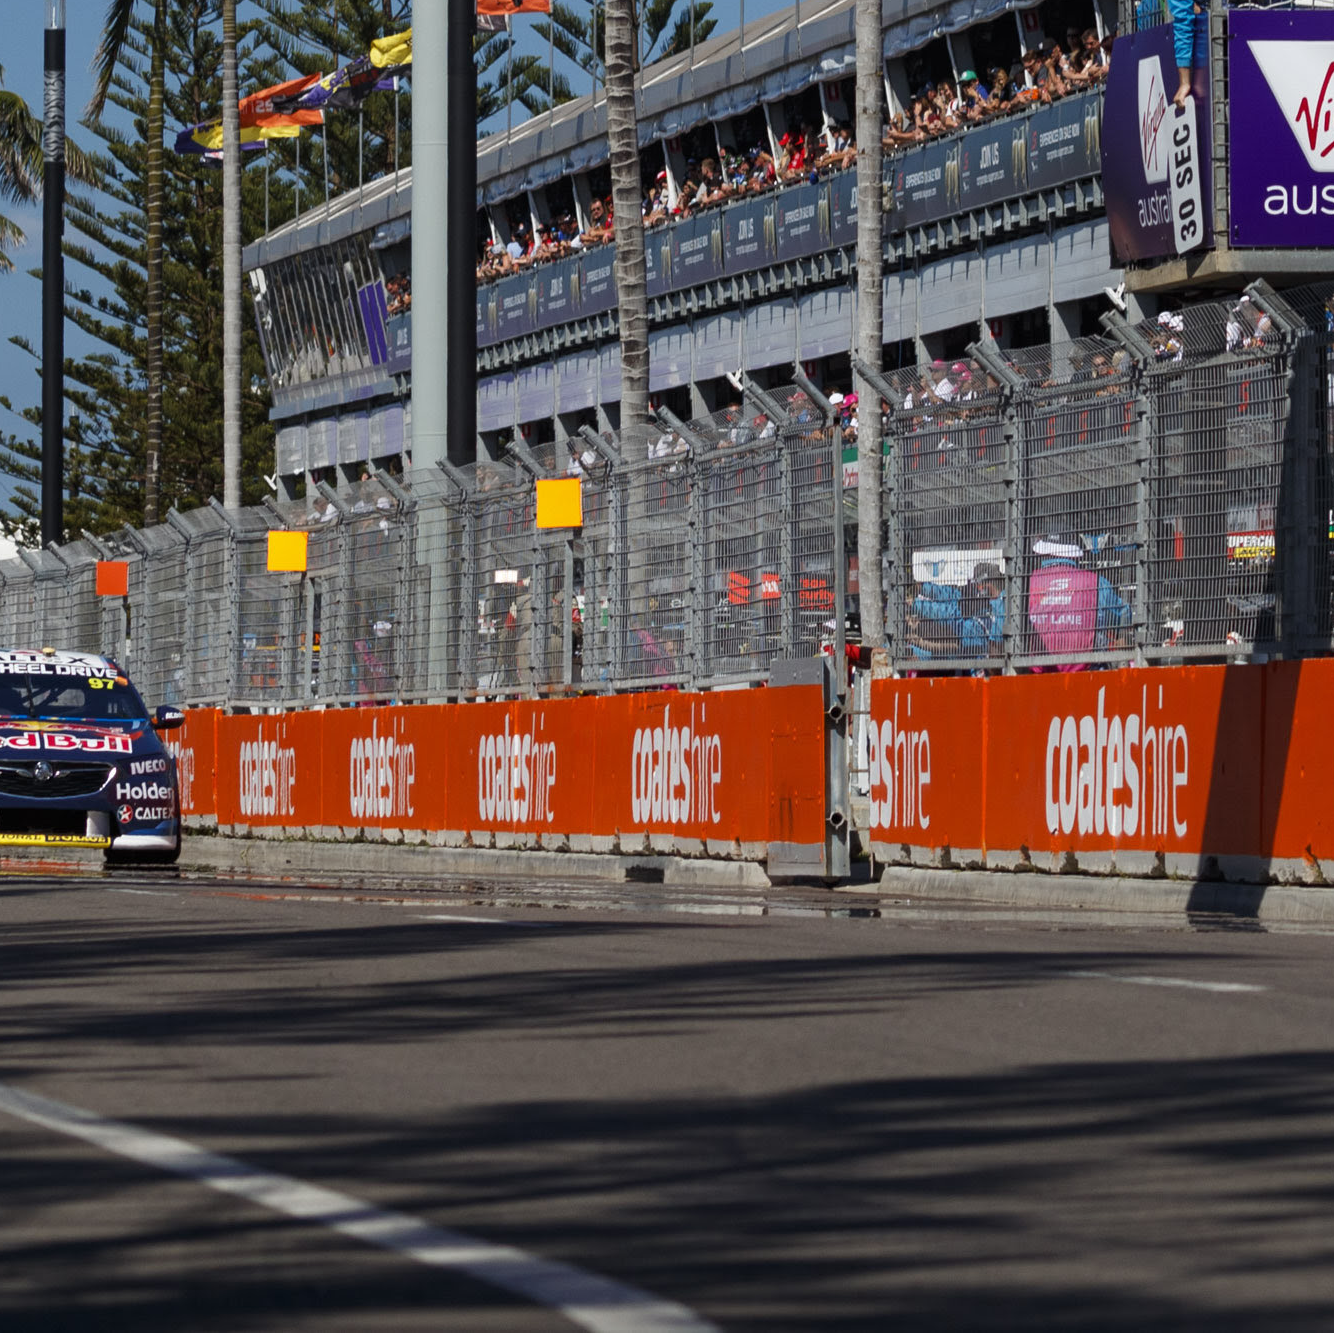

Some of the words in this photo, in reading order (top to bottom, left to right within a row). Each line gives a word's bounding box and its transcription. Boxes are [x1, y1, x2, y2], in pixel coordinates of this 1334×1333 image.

[1173, 122, 1194, 190] SEC
[1179, 197, 1198, 243] 30
[55, 664, 118, 679] DRIVE
[88, 678, 116, 690] 97
[43, 732, 133, 754] Bull
[130, 758, 167, 776] IVECO
[116, 781, 175, 801] Holden
[134, 805, 175, 821] CALTEX
